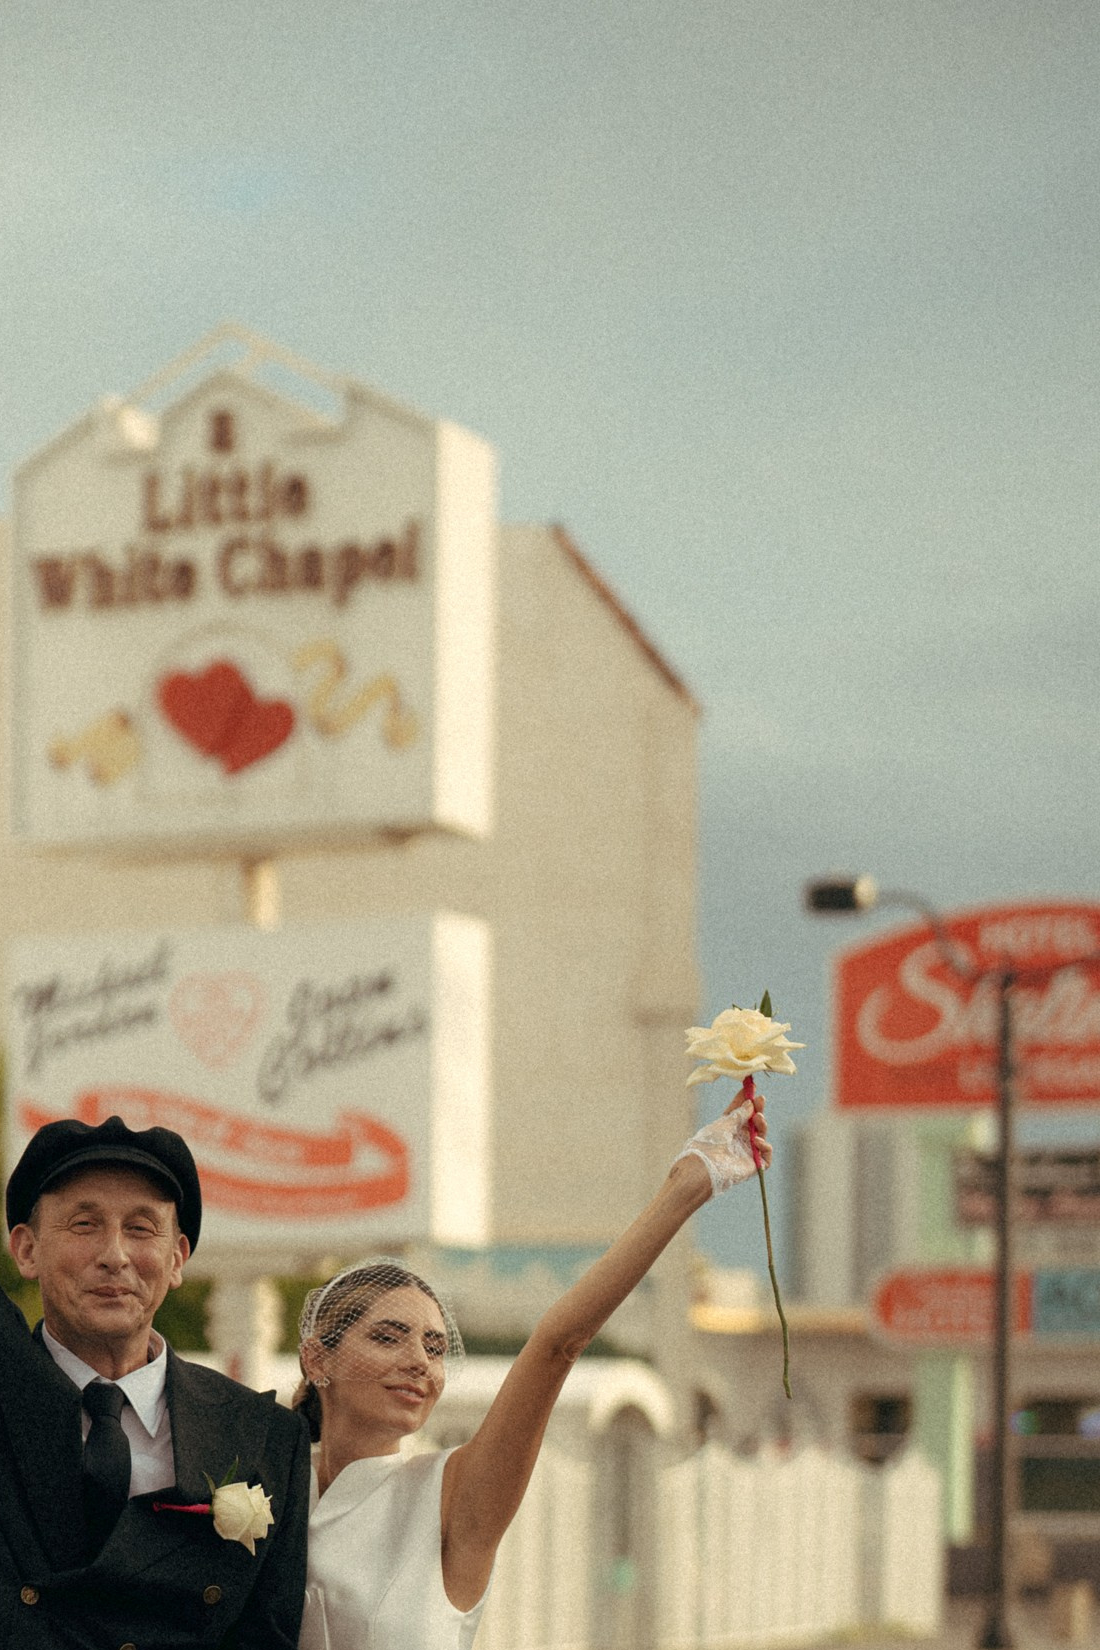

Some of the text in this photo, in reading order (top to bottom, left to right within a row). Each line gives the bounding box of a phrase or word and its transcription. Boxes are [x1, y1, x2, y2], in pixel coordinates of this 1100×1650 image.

[144, 465, 309, 534] Little
[31, 518, 421, 614] White Chapel
